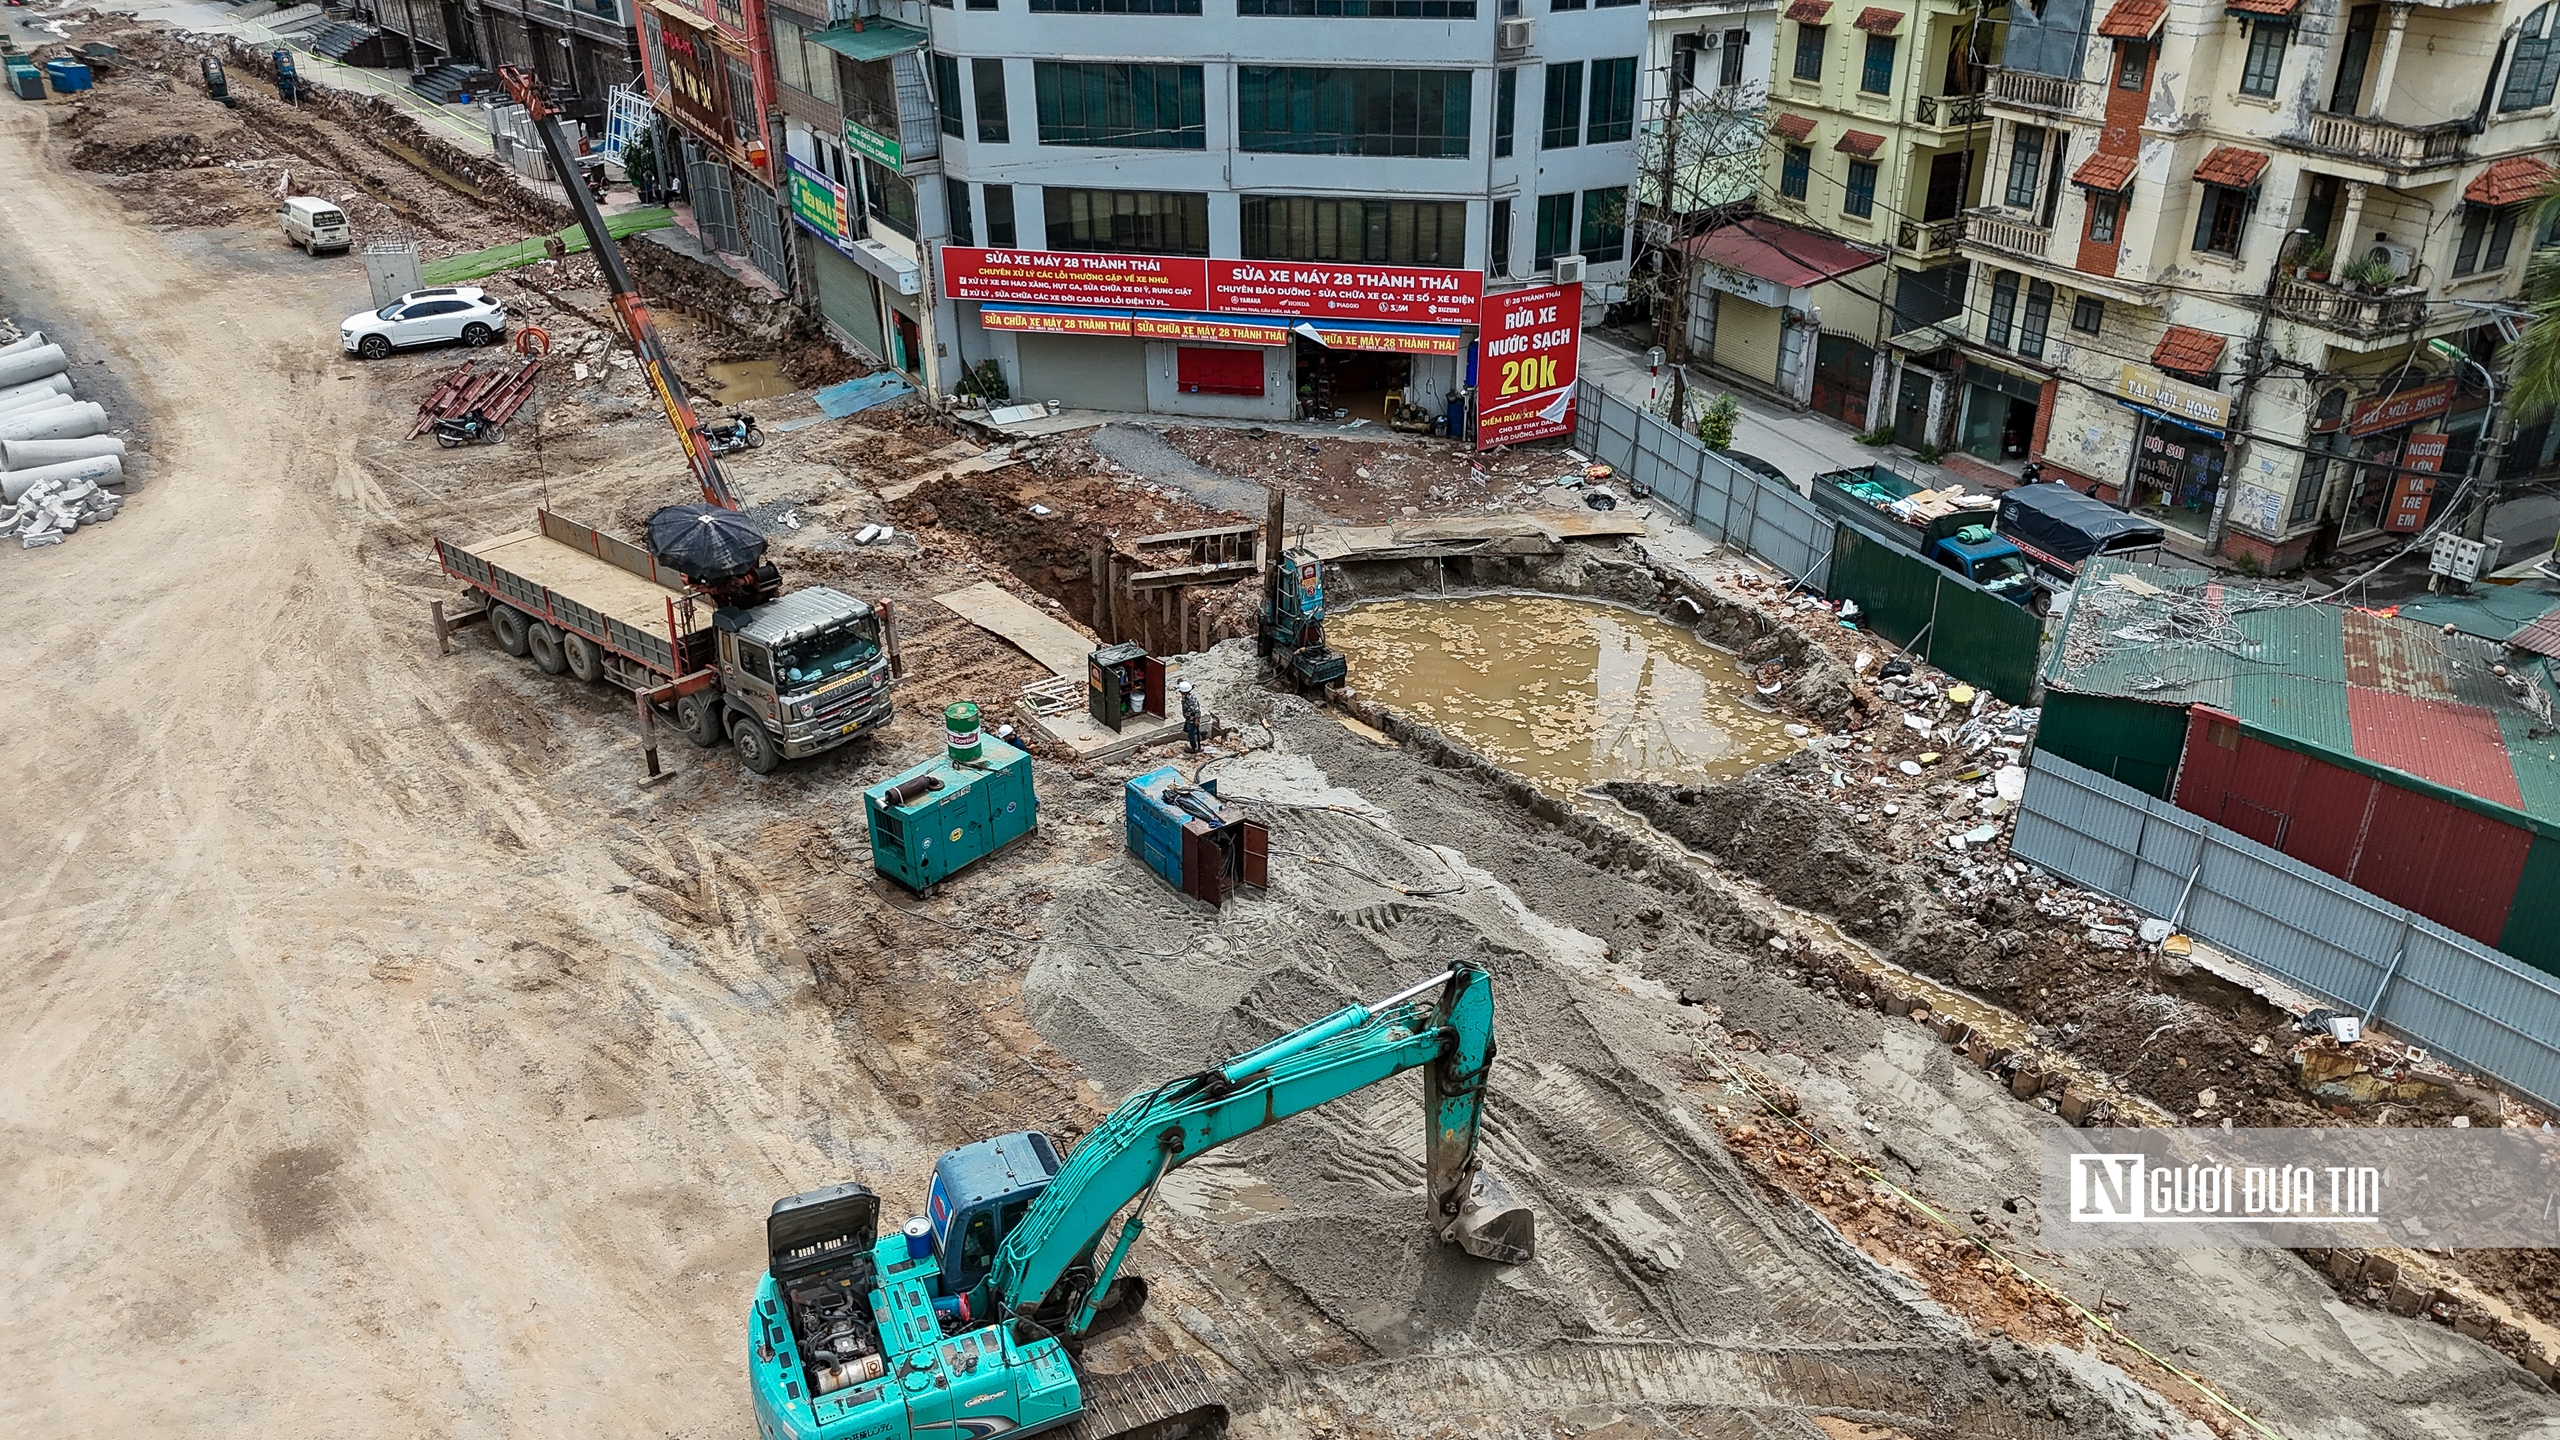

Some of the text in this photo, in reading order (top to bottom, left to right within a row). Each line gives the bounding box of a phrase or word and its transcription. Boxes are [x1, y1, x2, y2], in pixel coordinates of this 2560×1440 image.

[985, 251, 1161, 271] SỬA XE MÁY 28 THÀNH THÁI
[978, 268, 1011, 277] CHUYÊN
[1012, 269, 1025, 277] XỬ
[1055, 270, 1068, 279] LỖI
[1069, 273, 1104, 281] THƯỜNG
[1105, 274, 1122, 283] GẶP
[1232, 264, 1459, 290] SỬA XE MÁY 28 THÀNH THÁI
[968, 276, 979, 284] XỬ
[1028, 280, 1051, 289] XĂNG,
[1052, 283, 1067, 291] HỤT
[1083, 283, 1099, 291] SỬA
[1100, 284, 1121, 292] CHỮA
[1152, 287, 1173, 295] RUNG
[1174, 287, 1192, 297] GIẬT
[1217, 284, 1254, 295] CHUYÊN
[1256, 284, 1275, 296] BẢO
[1277, 286, 1311, 297] DƯỠNG
[1318, 287, 1338, 298] SỬA
[1340, 289, 1365, 300] CHỮA
[1367, 292, 1379, 300] XE
[1381, 293, 1395, 301] GA
[1402, 294, 1414, 302] XE
[1416, 292, 1430, 302] SỐ
[1437, 295, 1449, 303] XE
[1451, 295, 1475, 305] ĐIỆN
[1521, 294, 1545, 303] THÀNH
[1545, 290, 1561, 299] THÁI
[969, 288, 980, 297] XỬ
[995, 289, 1010, 298] SỬA
[1011, 290, 1032, 299] CHỮA
[1094, 295, 1110, 303] BÁO
[1111, 295, 1124, 304] LỖI
[1125, 297, 1144, 306] ĐIỆN
[1145, 297, 1156, 305] TỬ
[985, 312, 1131, 332] SỬA CHỮA XE MÁY 28 THÀNH THÁI
[1505, 306, 1557, 330] RỬA XE
[1137, 321, 1155, 333] SỬA
[1156, 322, 1180, 334] CHỮA
[1183, 326, 1194, 335] XE
[1196, 325, 1217, 336] MÁY
[1218, 328, 1230, 337] 28
[1232, 326, 1262, 340] THÀNH
[1265, 327, 1286, 341] THÁI
[1345, 335, 1357, 345] XE
[1360, 334, 1381, 347] MÁY
[1383, 338, 1396, 347] 28
[1398, 335, 1430, 349] THÀNH
[1433, 337, 1455, 350] THÁI
[1488, 328, 1571, 357] NƯỚC SẠCH
[1501, 355, 1558, 396] 20k
[2127, 379, 2149, 399] TAI
[2155, 389, 2178, 409] MŨI
[2184, 399, 2220, 421] HỌNG
[2414, 393, 2446, 413] HỌNG
[1481, 415, 1502, 427] ĐIỂM
[1504, 411, 1521, 423] RỬA
[1523, 410, 1534, 420] XE
[1498, 426, 1512, 434] CHO
[1523, 421, 1540, 429] THAY
[1485, 437, 1495, 445] VÀ
[1495, 435, 1509, 443] BẢO
[1535, 427, 1549, 435] SỬA
[1549, 424, 1567, 433] CHỮA
[2145, 435, 2186, 460] NỘI SOI
[2408, 441, 2445, 457] NGƯỜI
[2138, 472, 2173, 491] HỌNG
[2396, 514, 2416, 527] EM
